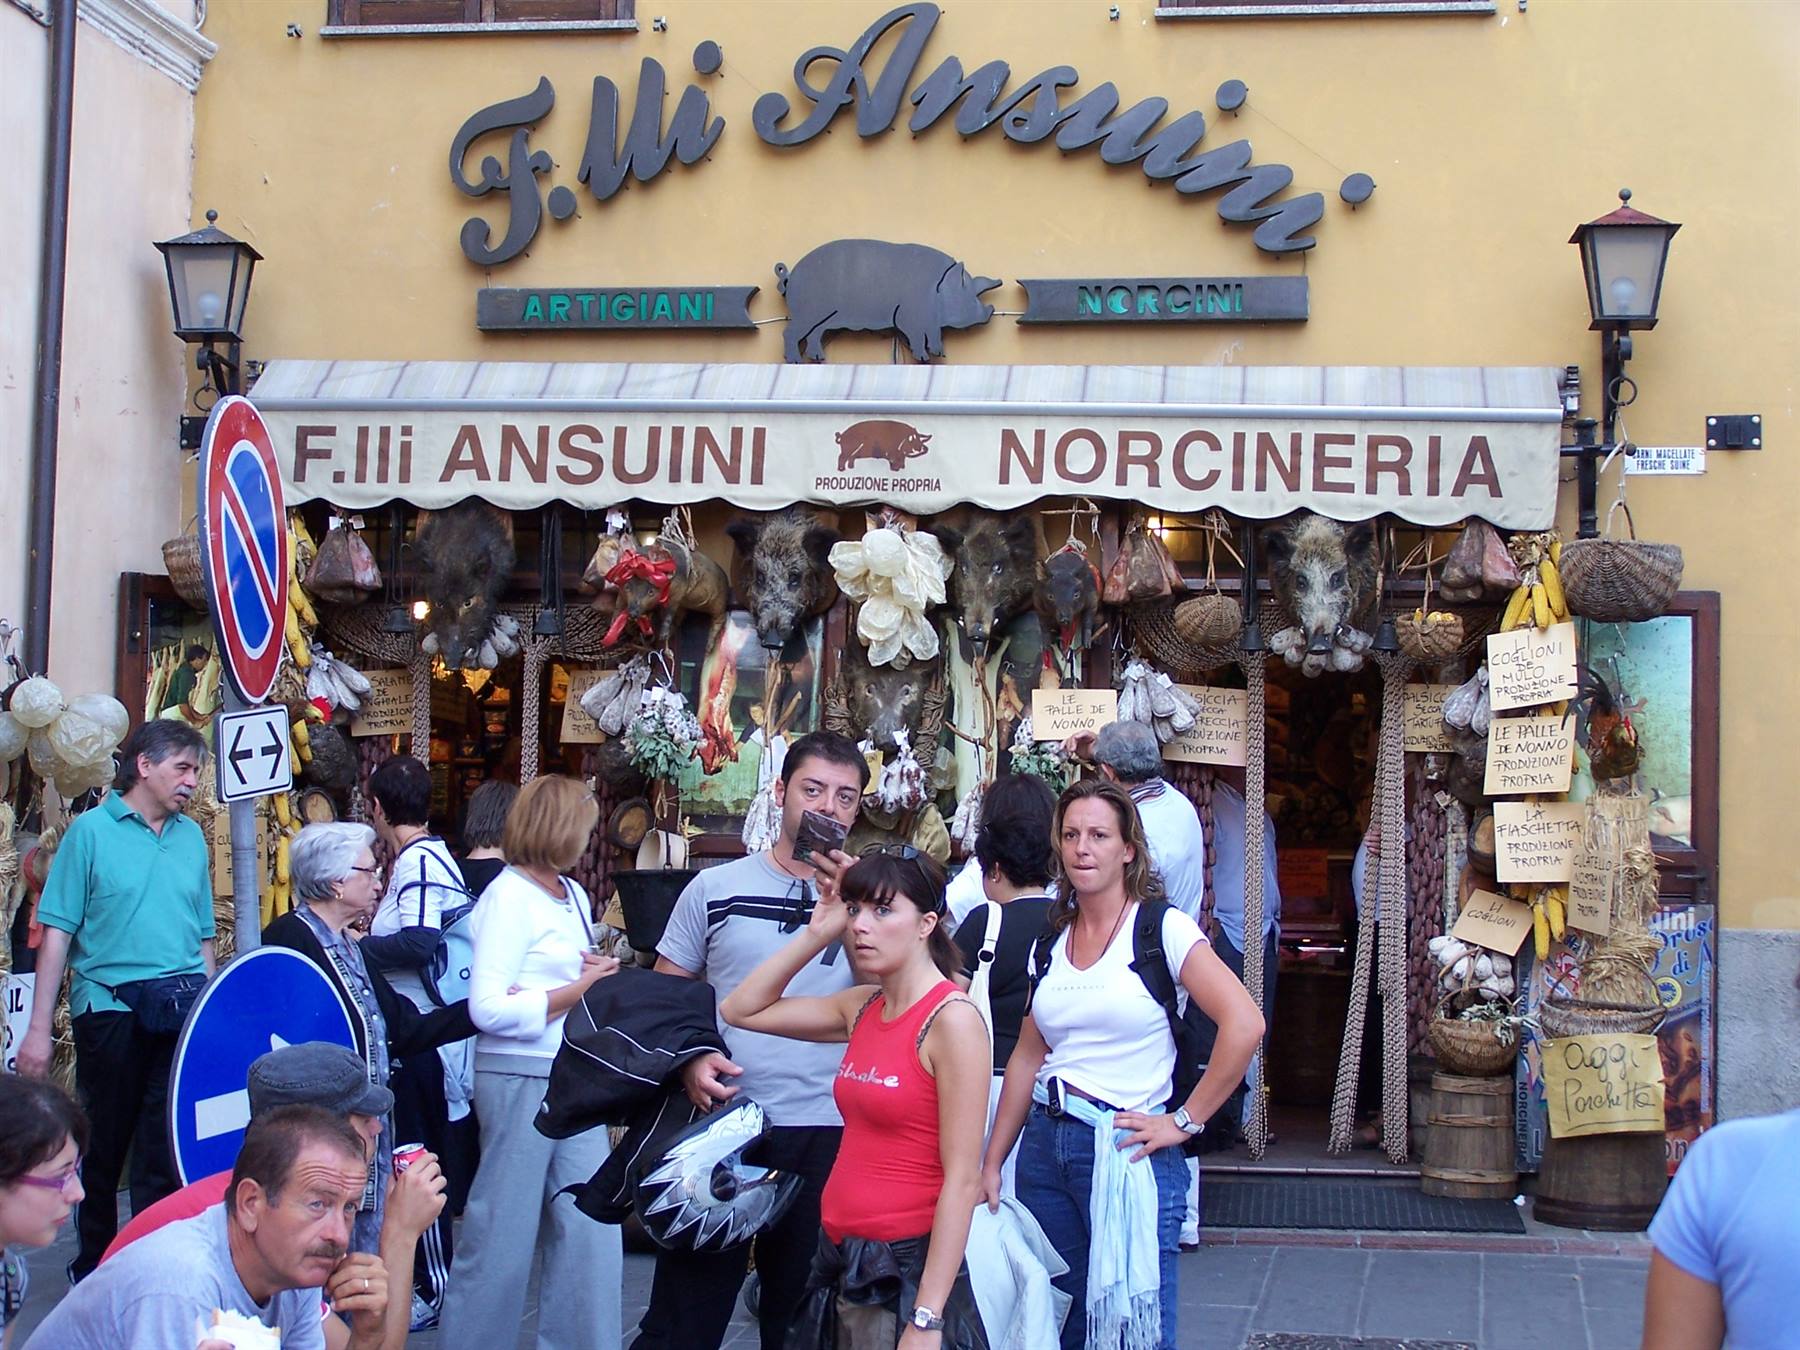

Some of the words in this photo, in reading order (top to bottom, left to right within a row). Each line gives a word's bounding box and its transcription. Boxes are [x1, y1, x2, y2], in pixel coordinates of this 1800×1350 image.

[752, 2, 1375, 252] Ansuini
[522, 291, 715, 322] ARTIGIANI
[1078, 284, 1243, 315] NORCINI
[293, 424, 412, 484] F.lli
[439, 424, 765, 486] ANSUINI
[1632, 448, 1652, 459] ARNI
[1656, 448, 1695, 459] MACELLATE
[1000, 428, 1503, 498] NORCINERIA
[1636, 460, 1665, 470] FRESCHE
[1670, 460, 1690, 470] SUINE
[815, 477, 889, 492] PRODUZIONE
[891, 478, 941, 492] PROPRIA
[1514, 635, 1530, 651] LI
[1491, 642, 1562, 666] COGLIONI
[1502, 665, 1545, 684] MULO
[1515, 661, 1534, 672] DE
[1495, 674, 1566, 697] PRODUZIONE
[1062, 694, 1076, 705] LE
[1511, 689, 1554, 704] PROPRIA
[1044, 705, 1083, 716] PALLE
[1090, 704, 1107, 714] DE
[1051, 717, 1095, 730] NONNO
[1495, 726, 1512, 741] LE
[1516, 724, 1559, 739] PALLE
[1495, 744, 1512, 754] DE
[1515, 738, 1568, 753] NONNO
[1493, 755, 1567, 772] PRODUZIONE
[1500, 773, 1555, 787] PROPRIA
[1526, 809, 1546, 822] LA
[1496, 820, 1582, 837] FIASCHETTA
[1507, 838, 1574, 853] PRODUZIONE
[1510, 856, 1565, 869] PROPRIA
[1489, 902, 1503, 913] LI
[1467, 909, 1516, 928] COGLIONI
[1564, 1078, 1656, 1122] Porchetta
